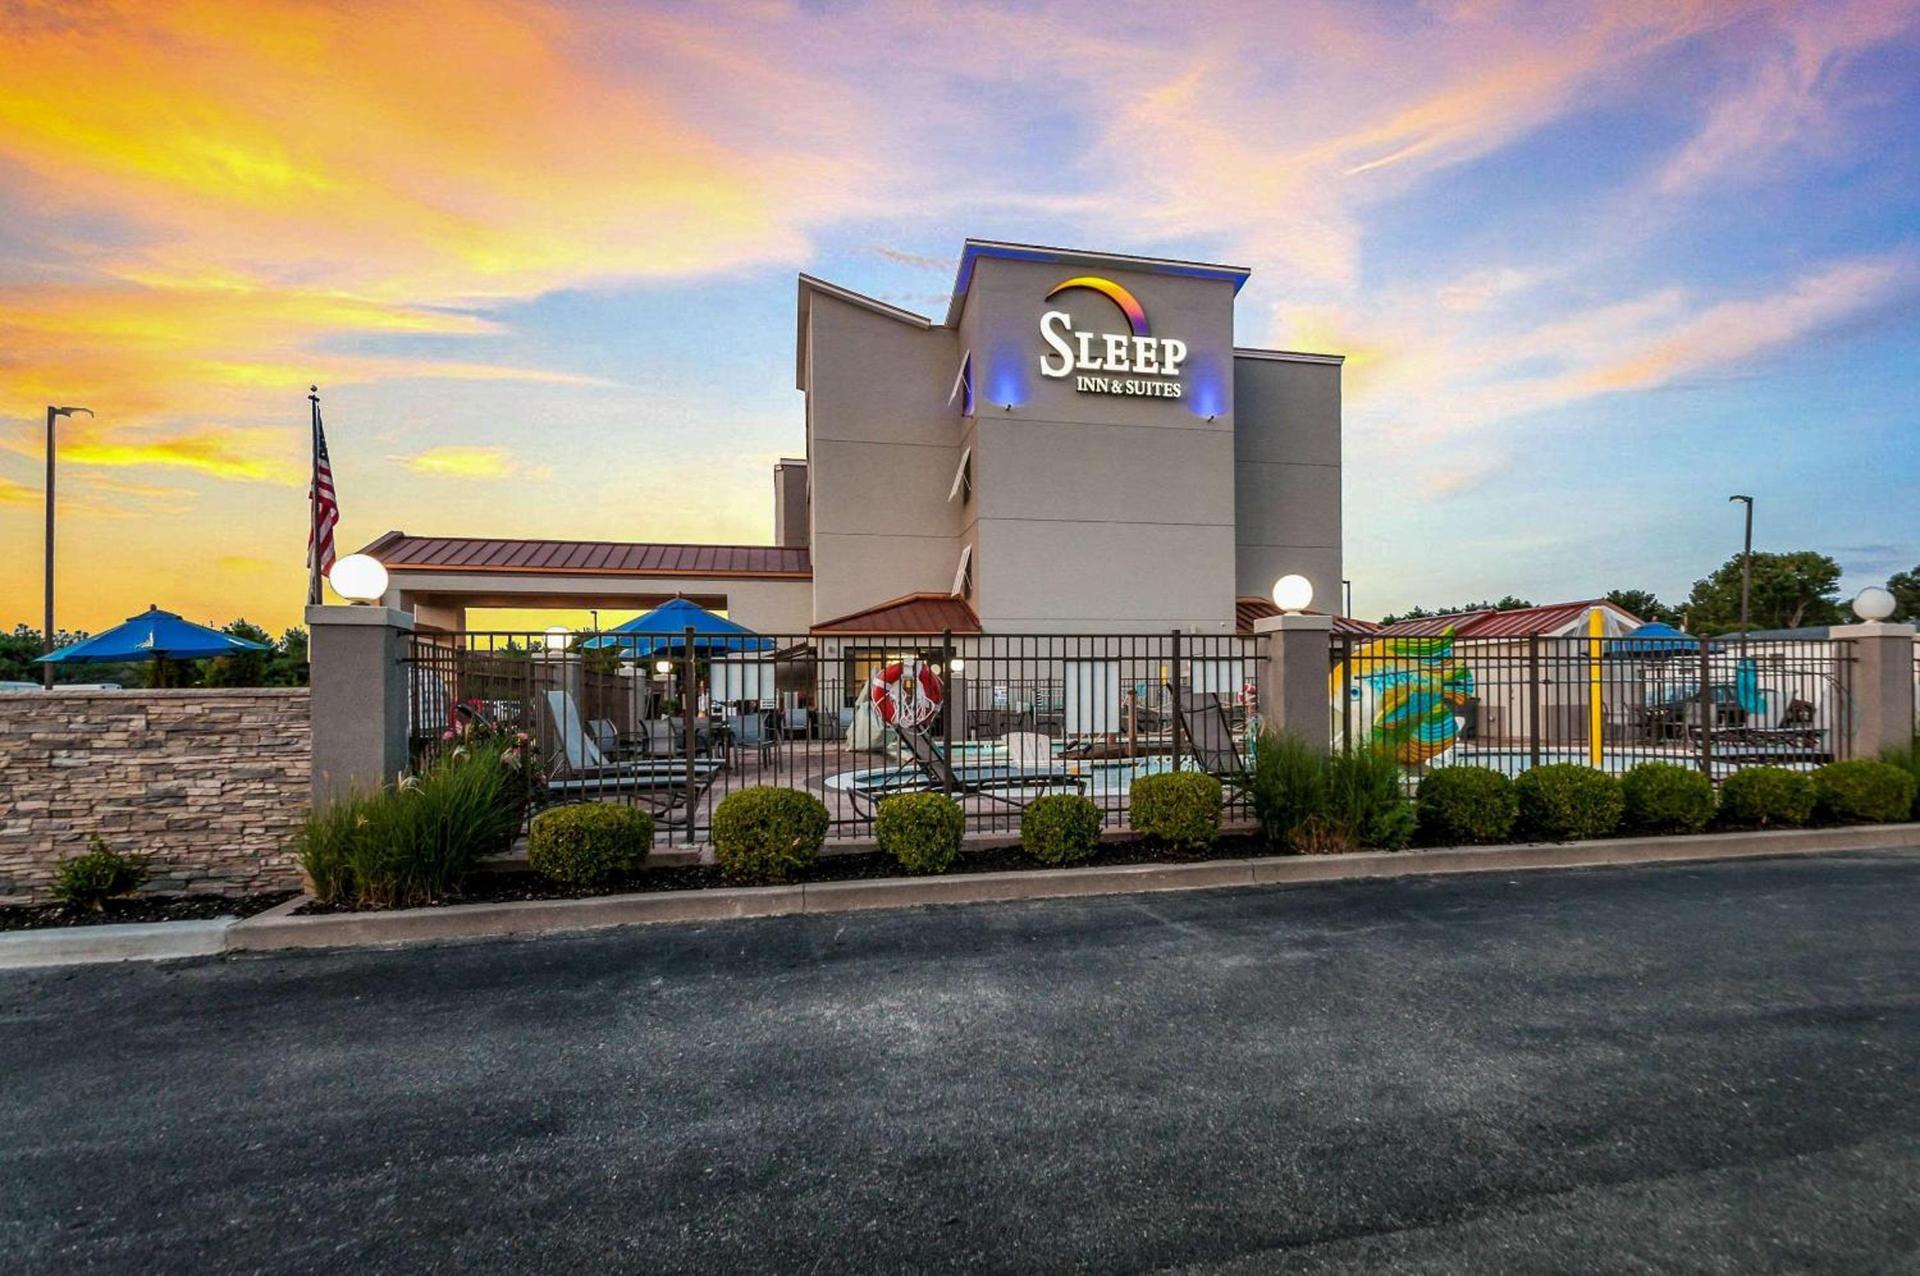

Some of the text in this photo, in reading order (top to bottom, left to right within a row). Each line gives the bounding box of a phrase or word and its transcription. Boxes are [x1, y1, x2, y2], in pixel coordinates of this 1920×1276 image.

[1040, 311, 1187, 377] SLEEP
[1077, 376, 1181, 398] INN & SUITES
